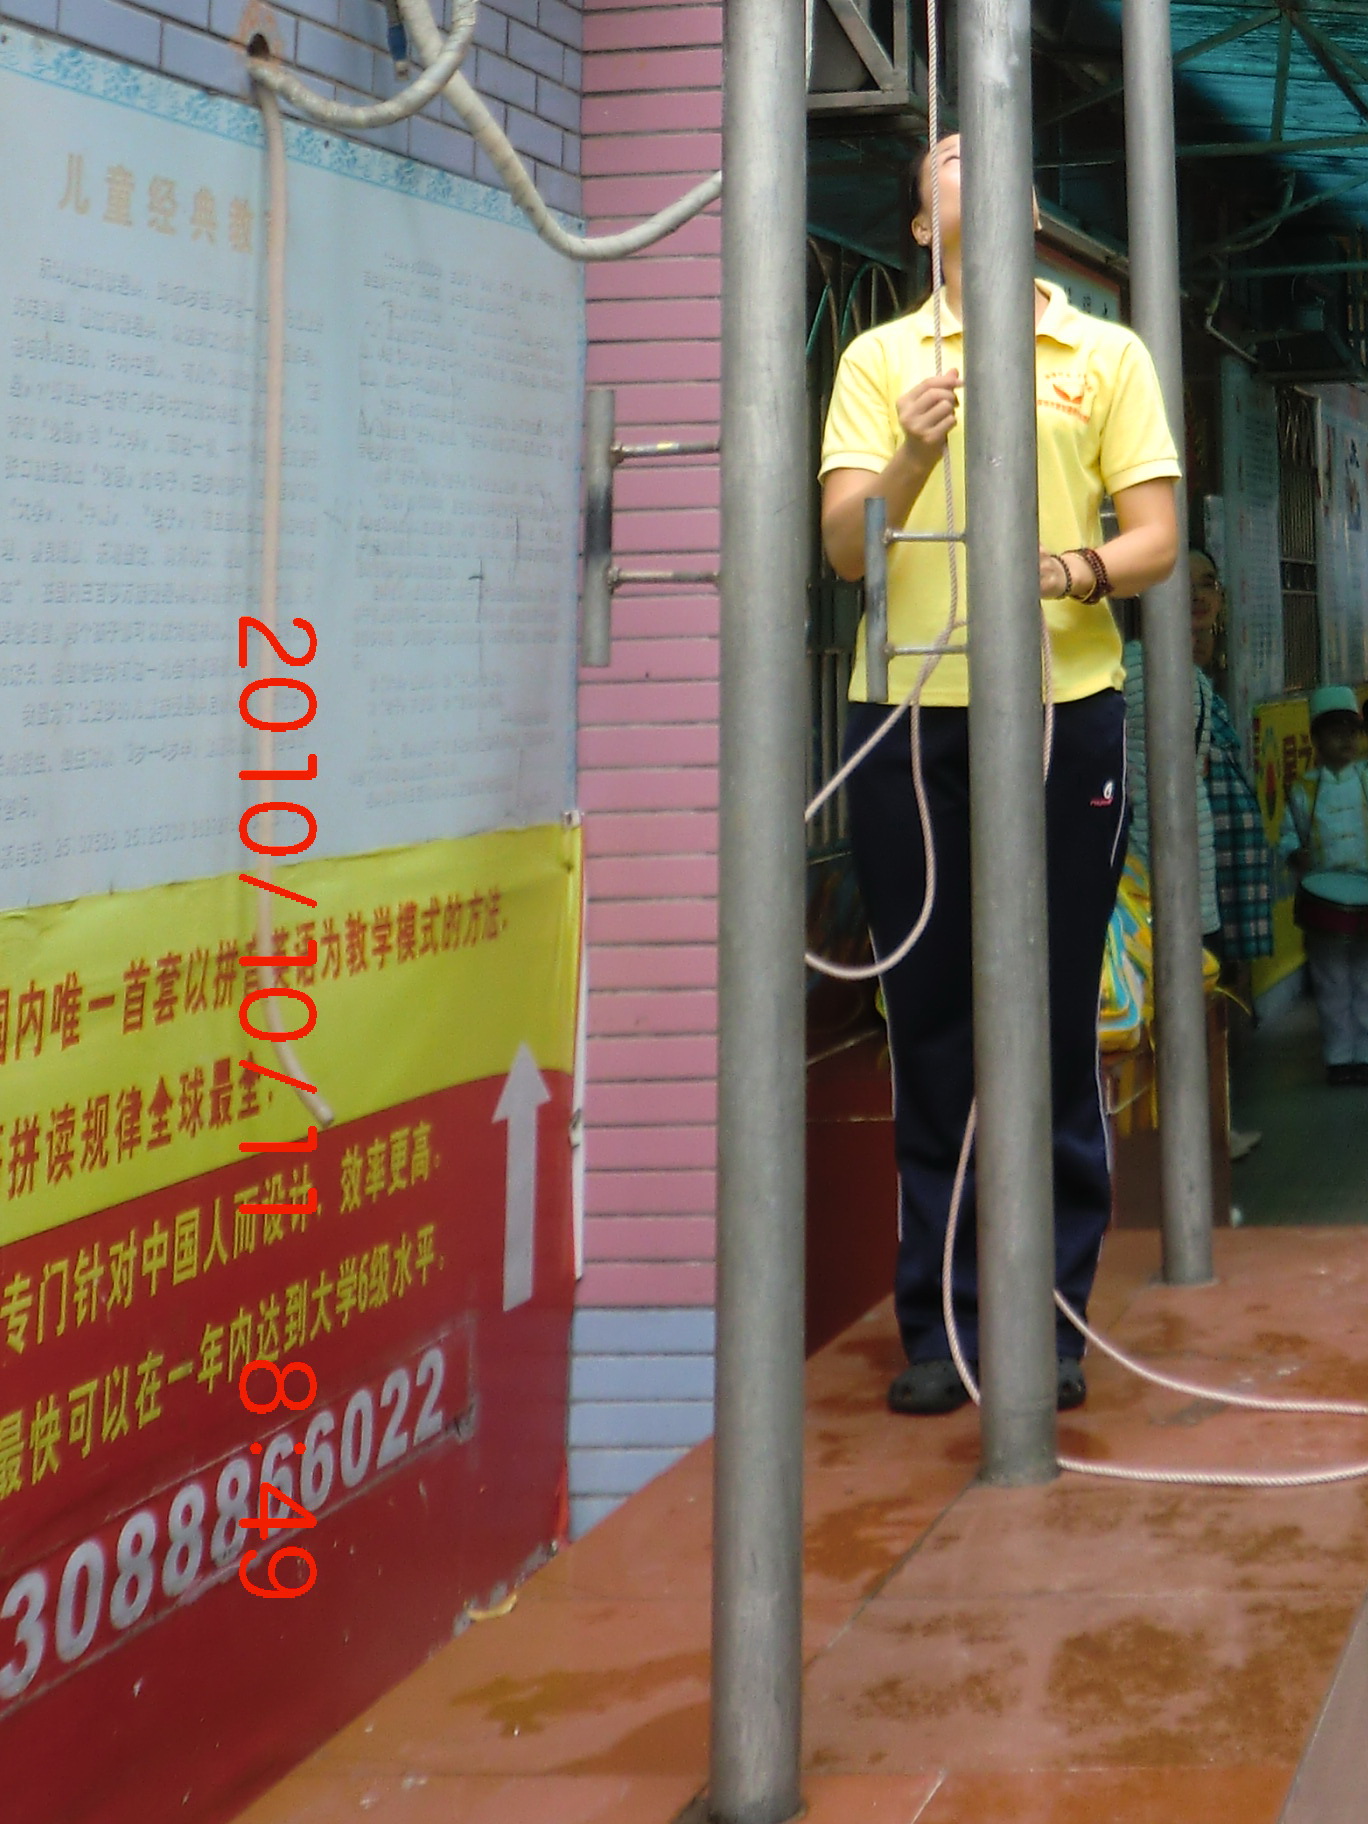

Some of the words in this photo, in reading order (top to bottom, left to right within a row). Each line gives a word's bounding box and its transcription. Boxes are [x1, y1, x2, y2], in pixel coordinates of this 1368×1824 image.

[58, 152, 270, 254] 儿童经典教
